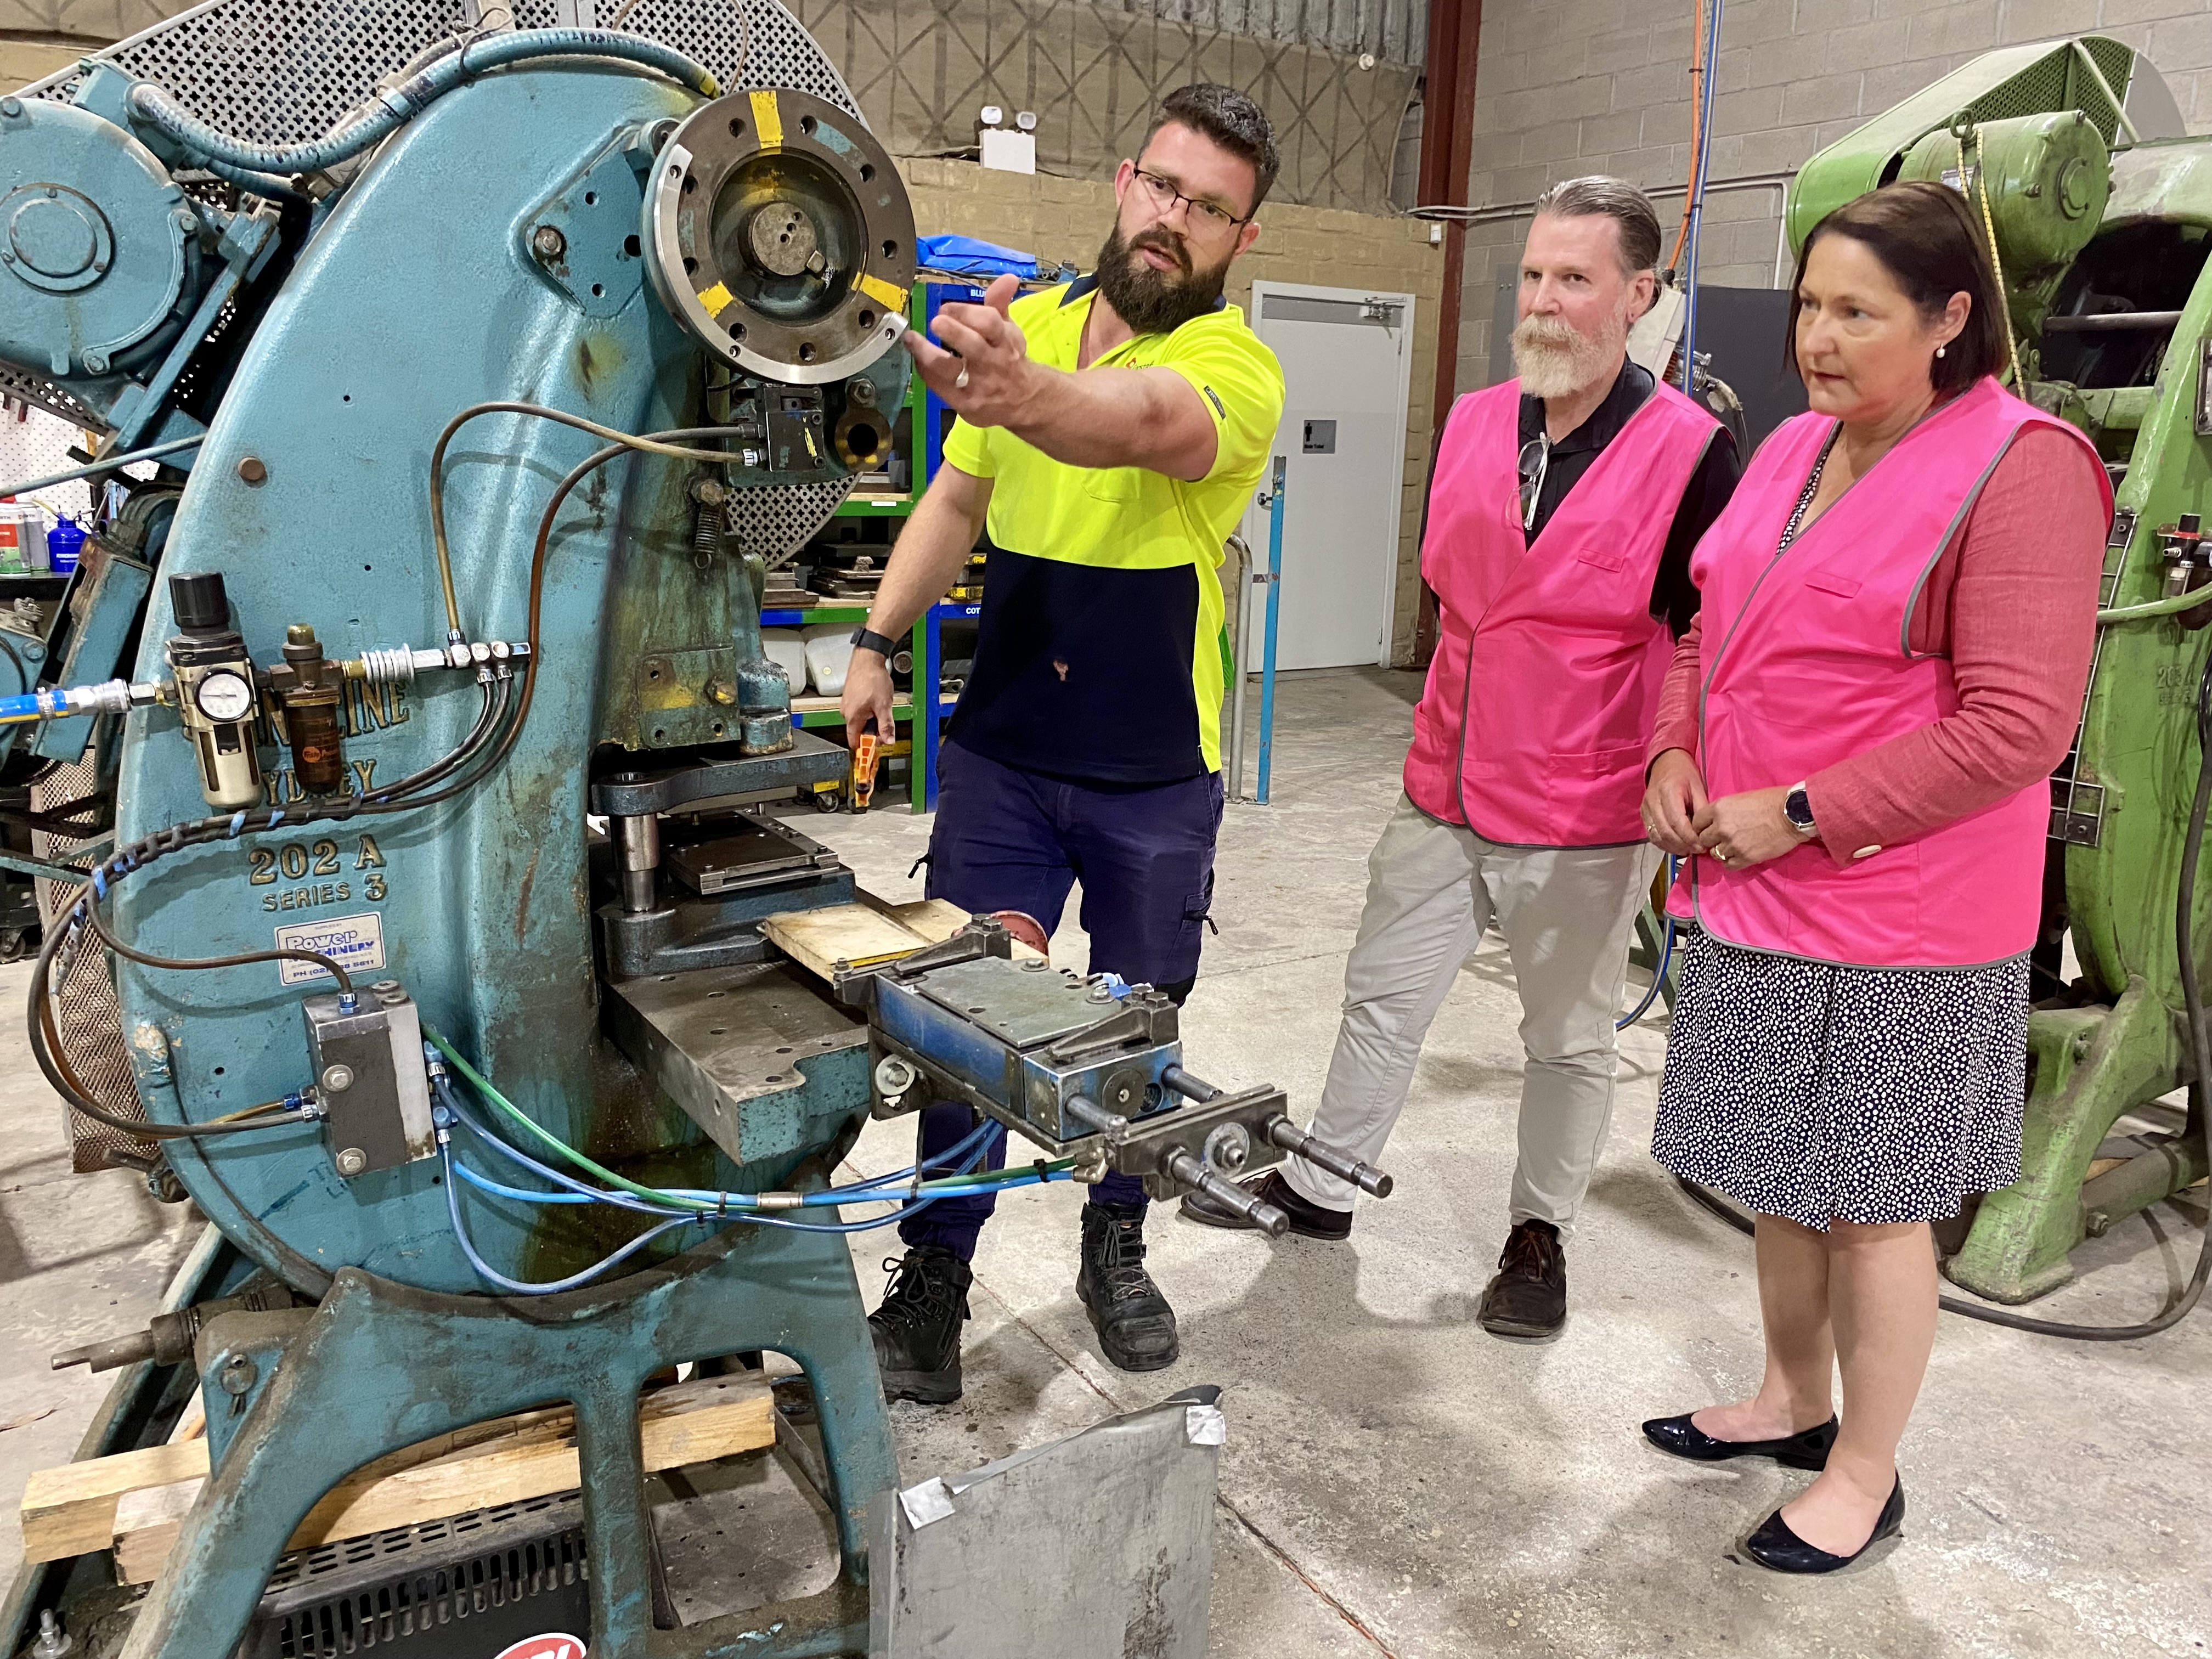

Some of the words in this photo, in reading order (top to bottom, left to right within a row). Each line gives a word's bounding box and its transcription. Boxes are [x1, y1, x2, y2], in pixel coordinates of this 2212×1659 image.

[249, 838, 340, 885] 202
[353, 834, 387, 870] A
[262, 882, 351, 912] SERIES
[364, 873, 388, 901] 3
[286, 930, 357, 950] Power
